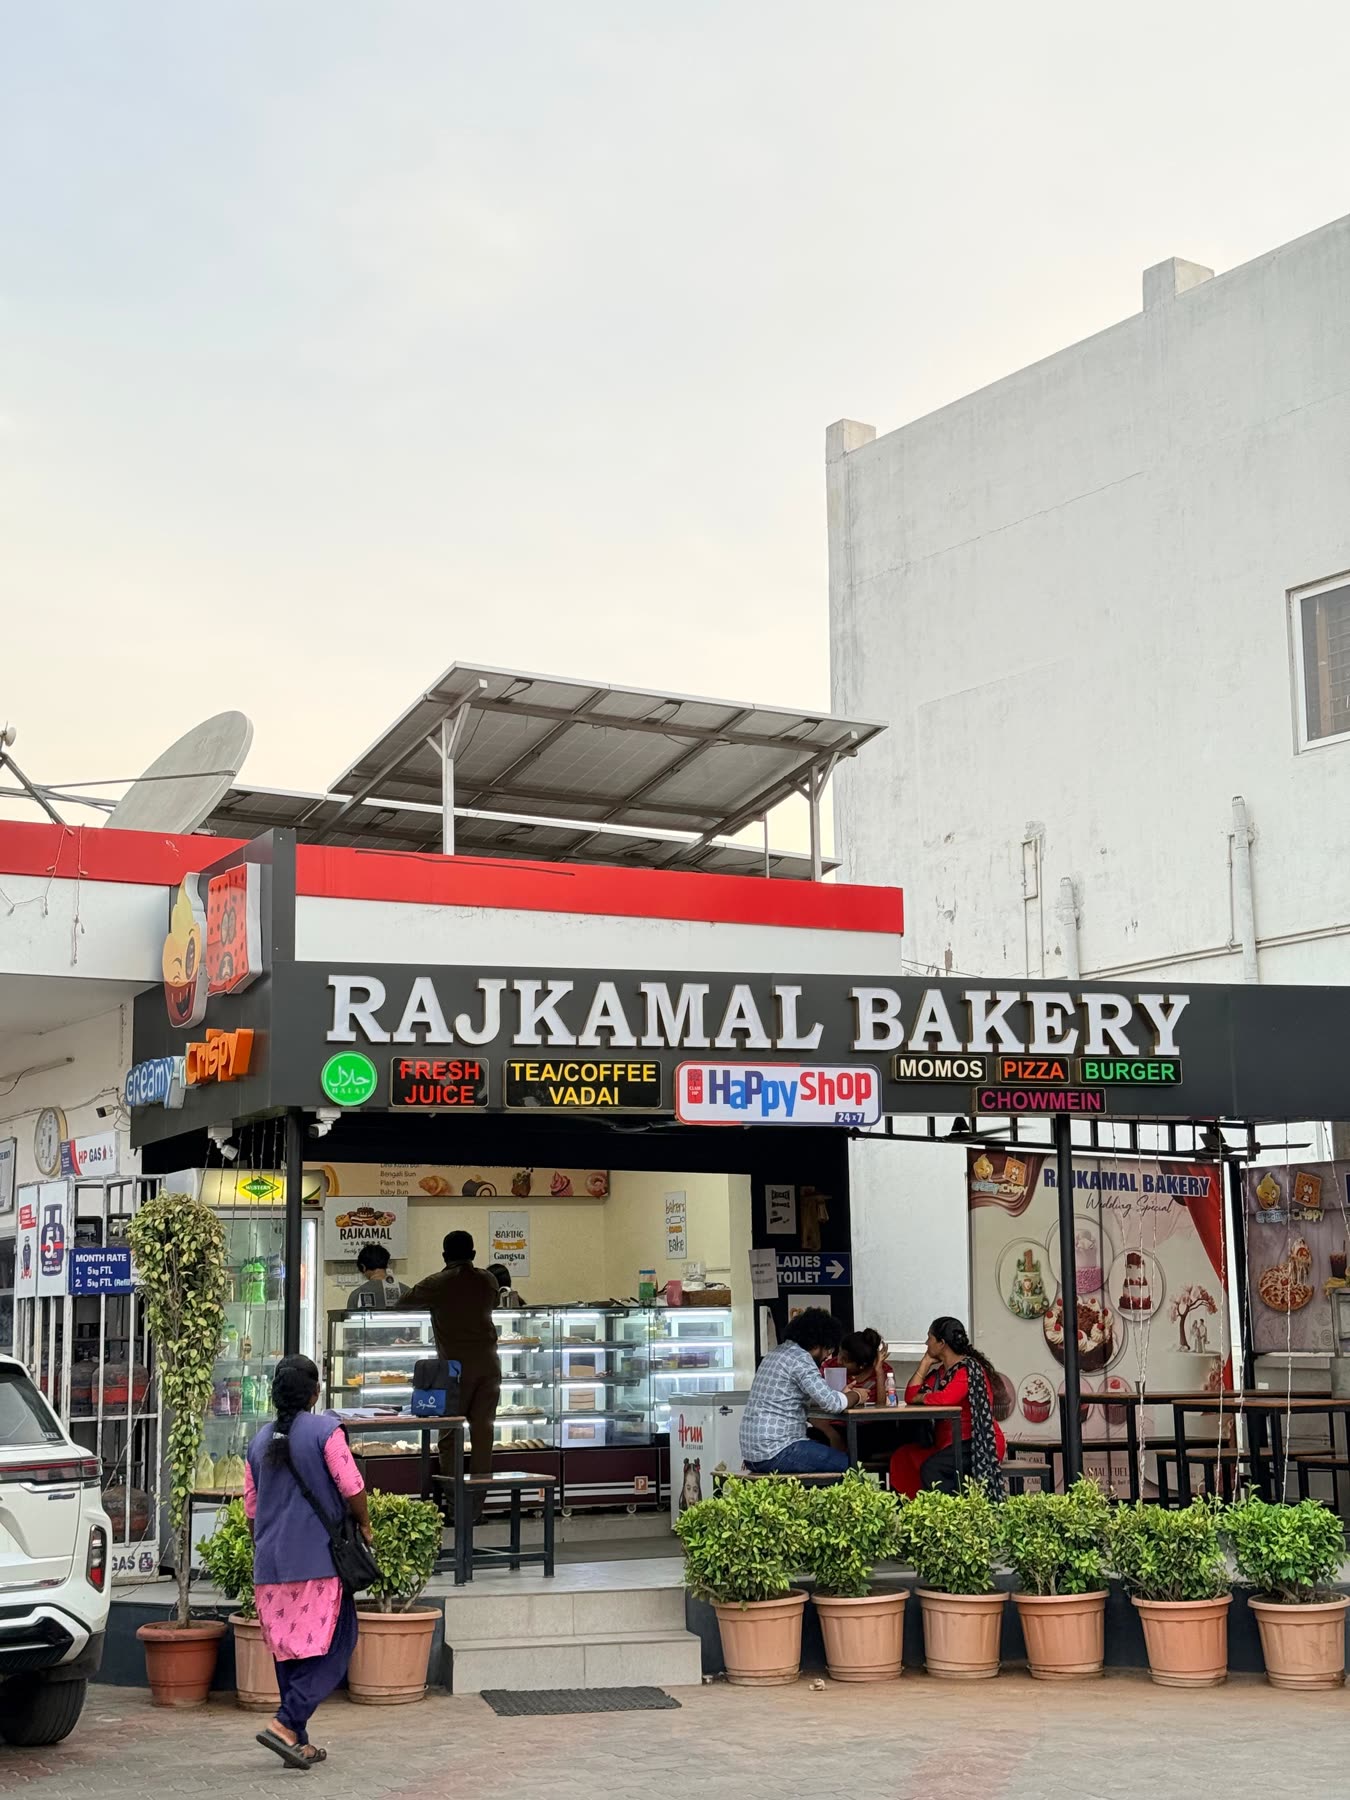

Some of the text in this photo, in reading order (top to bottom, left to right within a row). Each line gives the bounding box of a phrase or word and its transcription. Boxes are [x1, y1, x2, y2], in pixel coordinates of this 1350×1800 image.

[326, 974, 1191, 1057] RAJKAMAL BAKERY
[328, 1065, 371, 1088] حلال
[400, 1060, 480, 1082] FRESH
[510, 1062, 657, 1084] TEA/COFFEE
[899, 1057, 1176, 1082] MOMOS PIZZA BURGER
[404, 1084, 475, 1105] JUICE
[549, 1085, 619, 1107] VADAI
[981, 1090, 1101, 1111] CHOWMEIN
[79, 1150, 88, 1164] HP
[89, 1147, 102, 1163] GAS
[1142, 1174, 1211, 1197] BAKERY
[1086, 1193, 1174, 1218] Wedding Special
[44, 1230, 54, 1259] 5
[340, 1228, 392, 1240] RAJKAMAL
[495, 1230, 524, 1239] BAKING
[75, 1253, 127, 1262] MONTH RATE
[494, 1252, 526, 1262] Gangsta
[777, 1256, 821, 1268] LADIES
[75, 1267, 82, 1275] 1.
[100, 1265, 113, 1275] FTL
[777, 1271, 821, 1284] TOILET
[75, 1279, 82, 1288] 2.
[100, 1278, 113, 1287] FTL
[678, 1413, 704, 1448] Arun
[111, 1555, 135, 1571] GAS
